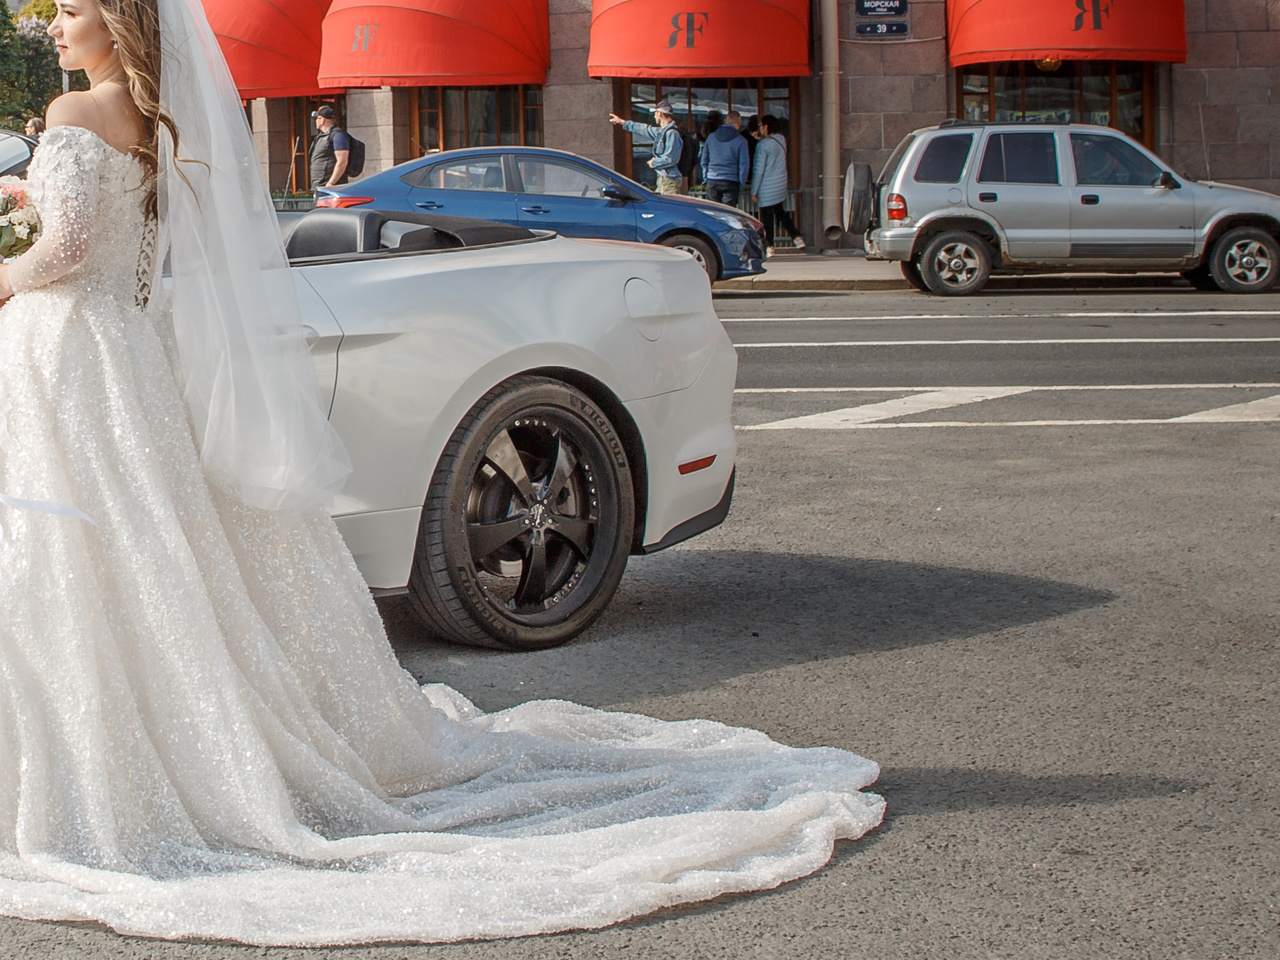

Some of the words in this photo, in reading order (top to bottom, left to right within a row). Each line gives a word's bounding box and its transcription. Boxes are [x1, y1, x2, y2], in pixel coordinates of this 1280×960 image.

[864, 0, 899, 8] МОРСКАЯ
[876, 24, 887, 33] 39
[583, 404, 625, 465] MICHELIN
